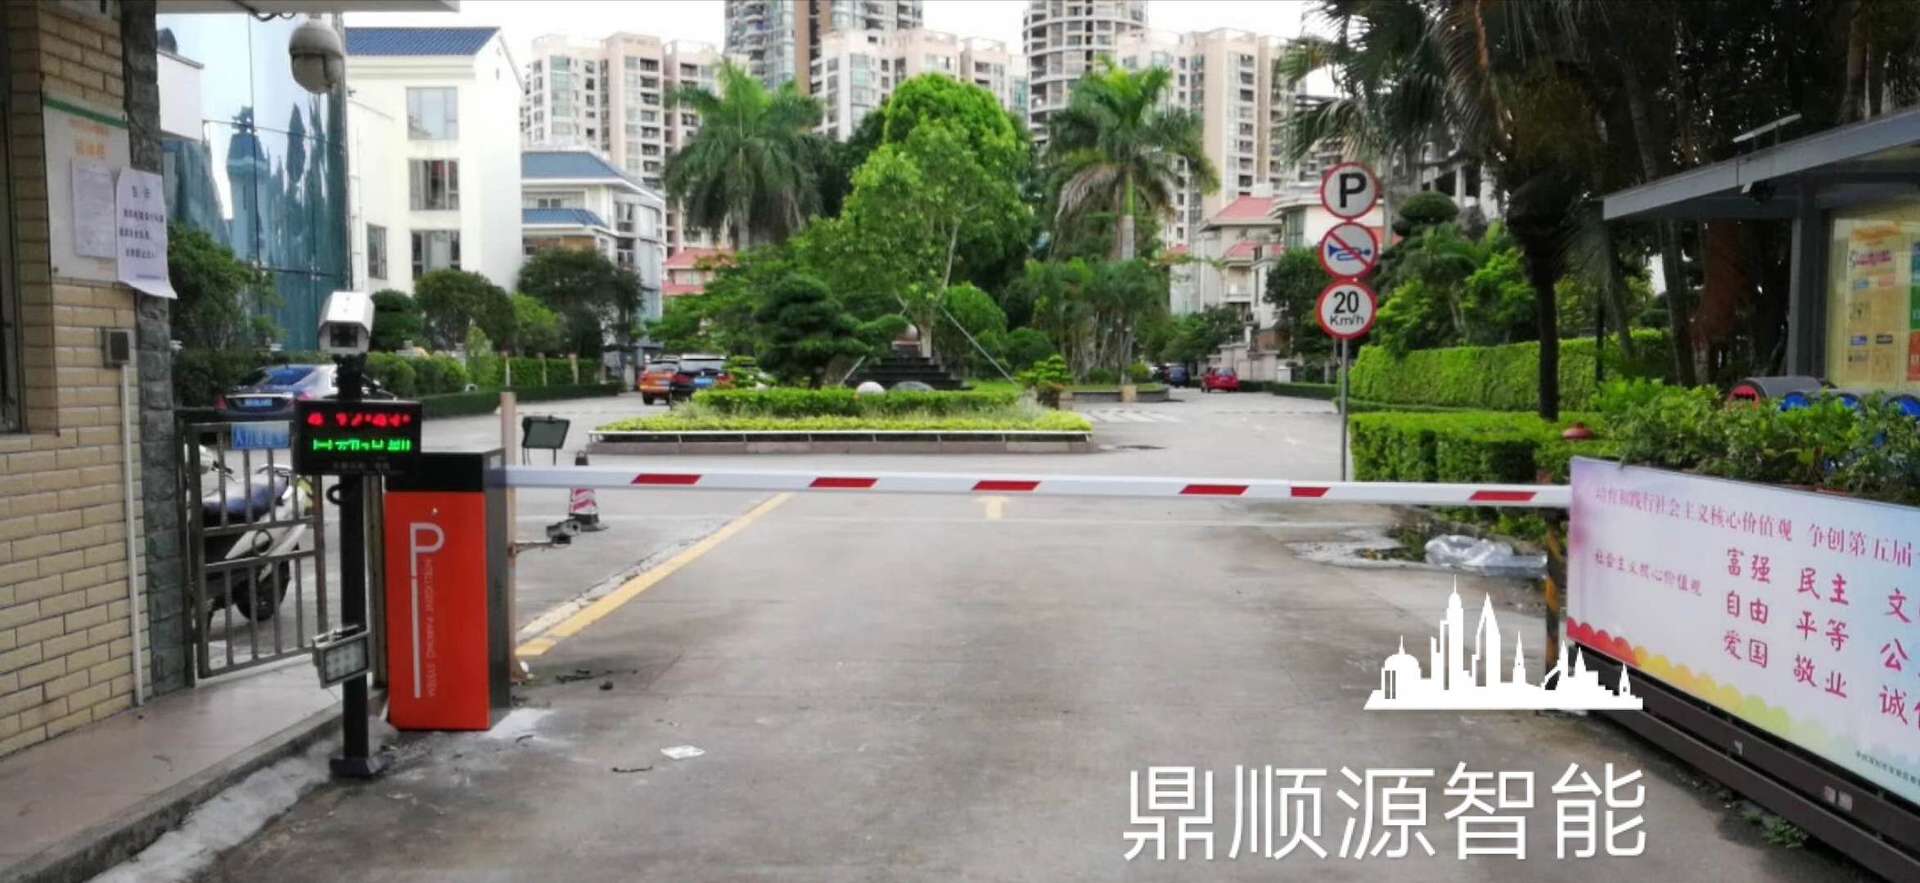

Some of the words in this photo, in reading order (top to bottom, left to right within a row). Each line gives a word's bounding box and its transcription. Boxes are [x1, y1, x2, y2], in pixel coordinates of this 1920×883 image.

[1339, 173, 1366, 208] P
[1330, 314, 1364, 326] Km/h
[1334, 291, 1359, 314] 20
[1727, 548, 1771, 584] 富强
[1798, 567, 1849, 605] 民主
[1727, 590, 1768, 625] 自由
[1796, 610, 1849, 651] 平等
[1724, 630, 1768, 669] 爱国
[1793, 654, 1847, 698] 敬业
